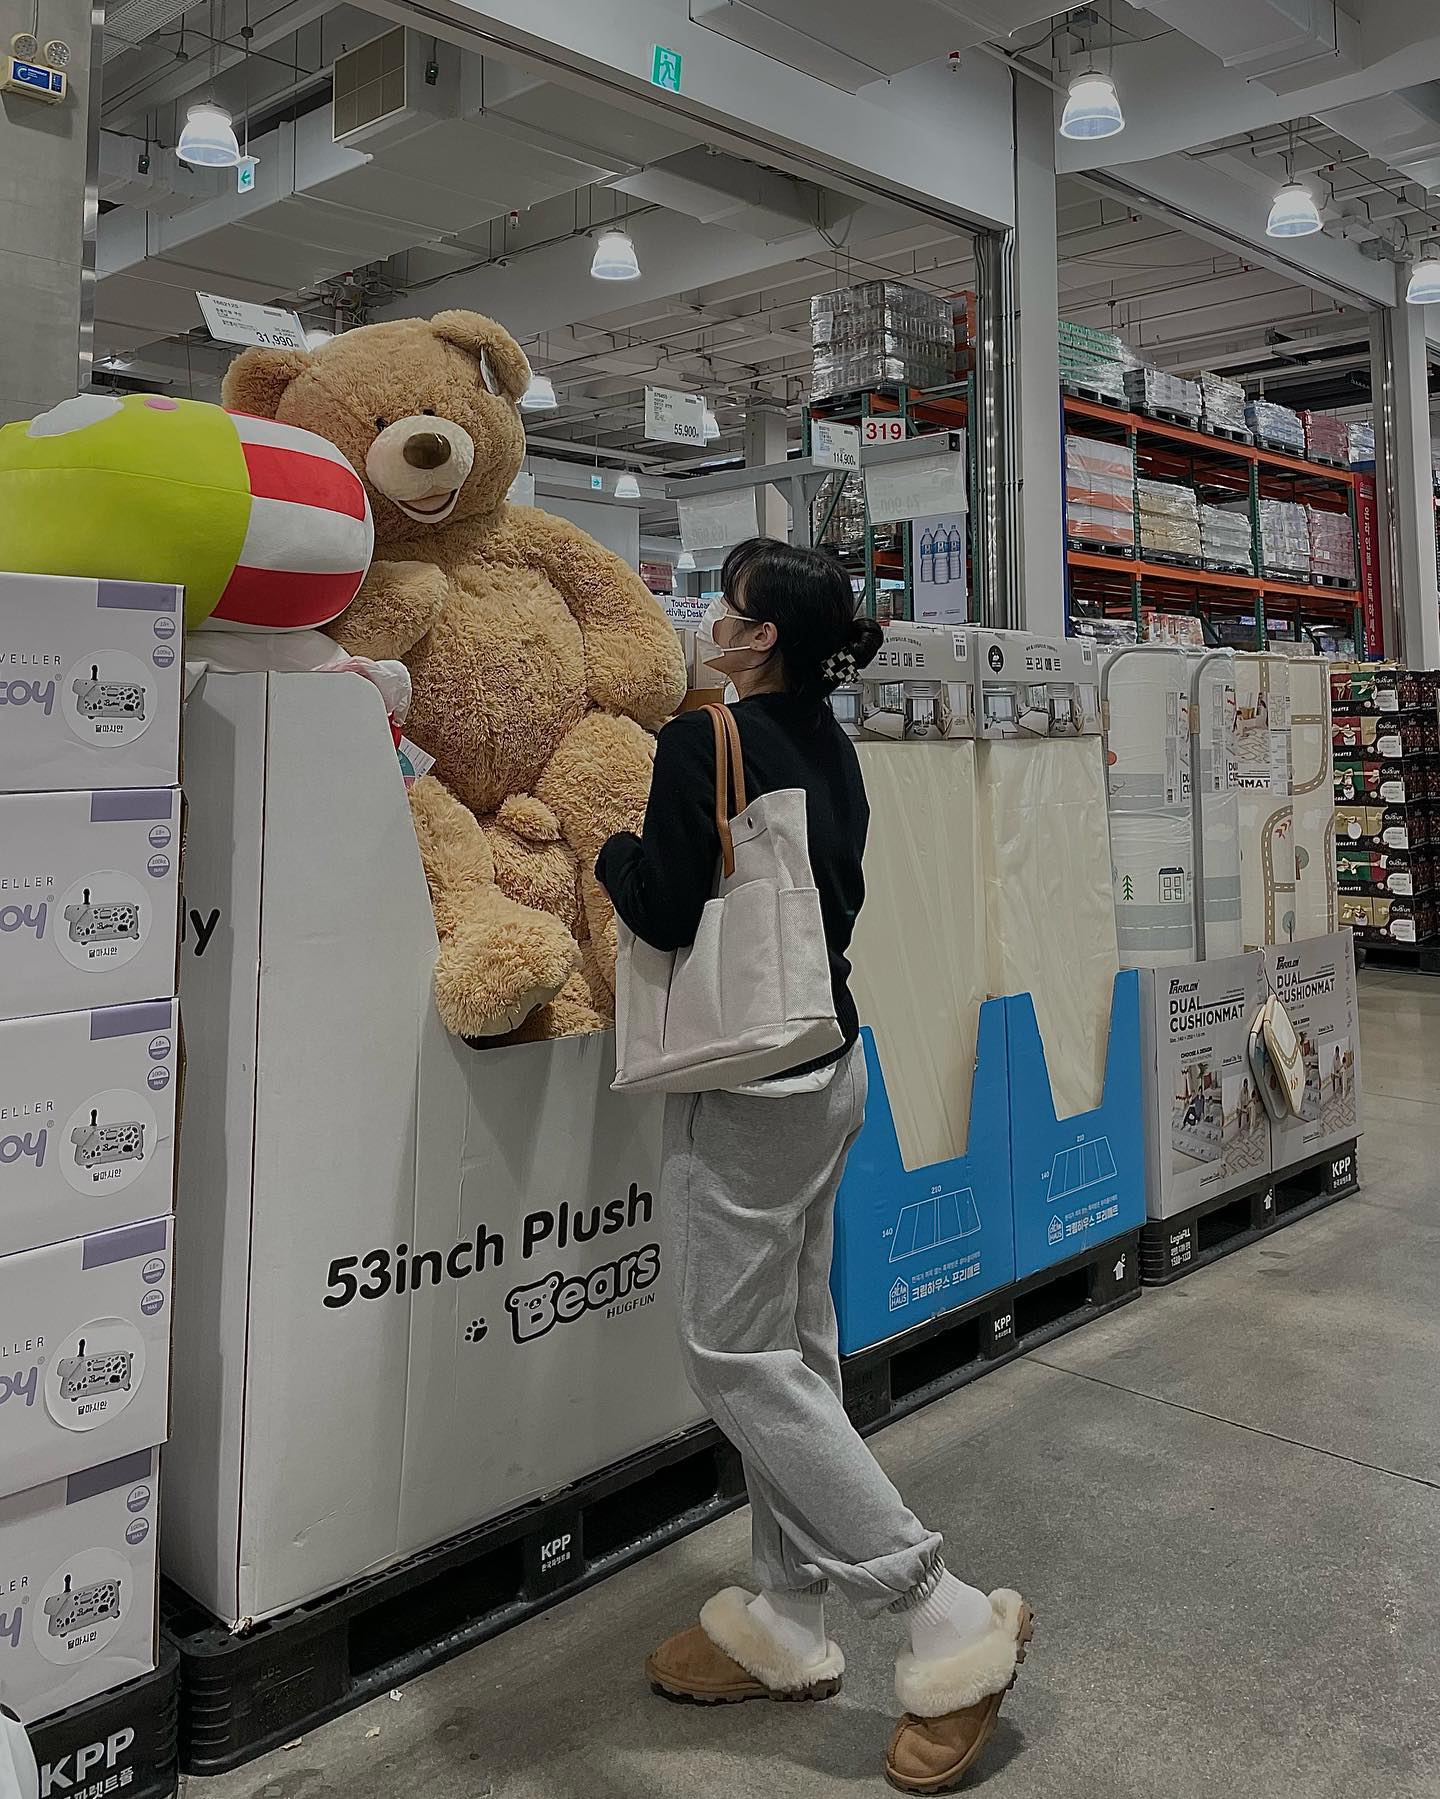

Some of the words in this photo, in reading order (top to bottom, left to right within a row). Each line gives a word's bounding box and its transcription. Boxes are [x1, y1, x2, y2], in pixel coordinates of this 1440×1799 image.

[865, 422, 902, 441] 319
[1, 876, 54, 889] ELLER
[1277, 971, 1302, 989] DUAL
[1169, 996, 1203, 1015] DUAL
[1169, 1004, 1245, 1033] CUSHIONMAT
[1, 1101, 53, 1119] ELLER
[1332, 1156, 1351, 1178] KPP
[931, 1184, 942, 1194] 210
[882, 1227, 894, 1238] 140
[323, 1223, 505, 1309] 53inch
[522, 1182, 653, 1259] Plush
[505, 1243, 662, 1345] Bears
[912, 1275, 950, 1302] 크림하우스
[606, 1293, 656, 1319] HUGFUN
[994, 1314, 1011, 1332] KPP
[3, 1336, 44, 1357] LLER
[541, 1534, 571, 1561] KPP
[41, 1727, 135, 1798] KPP
